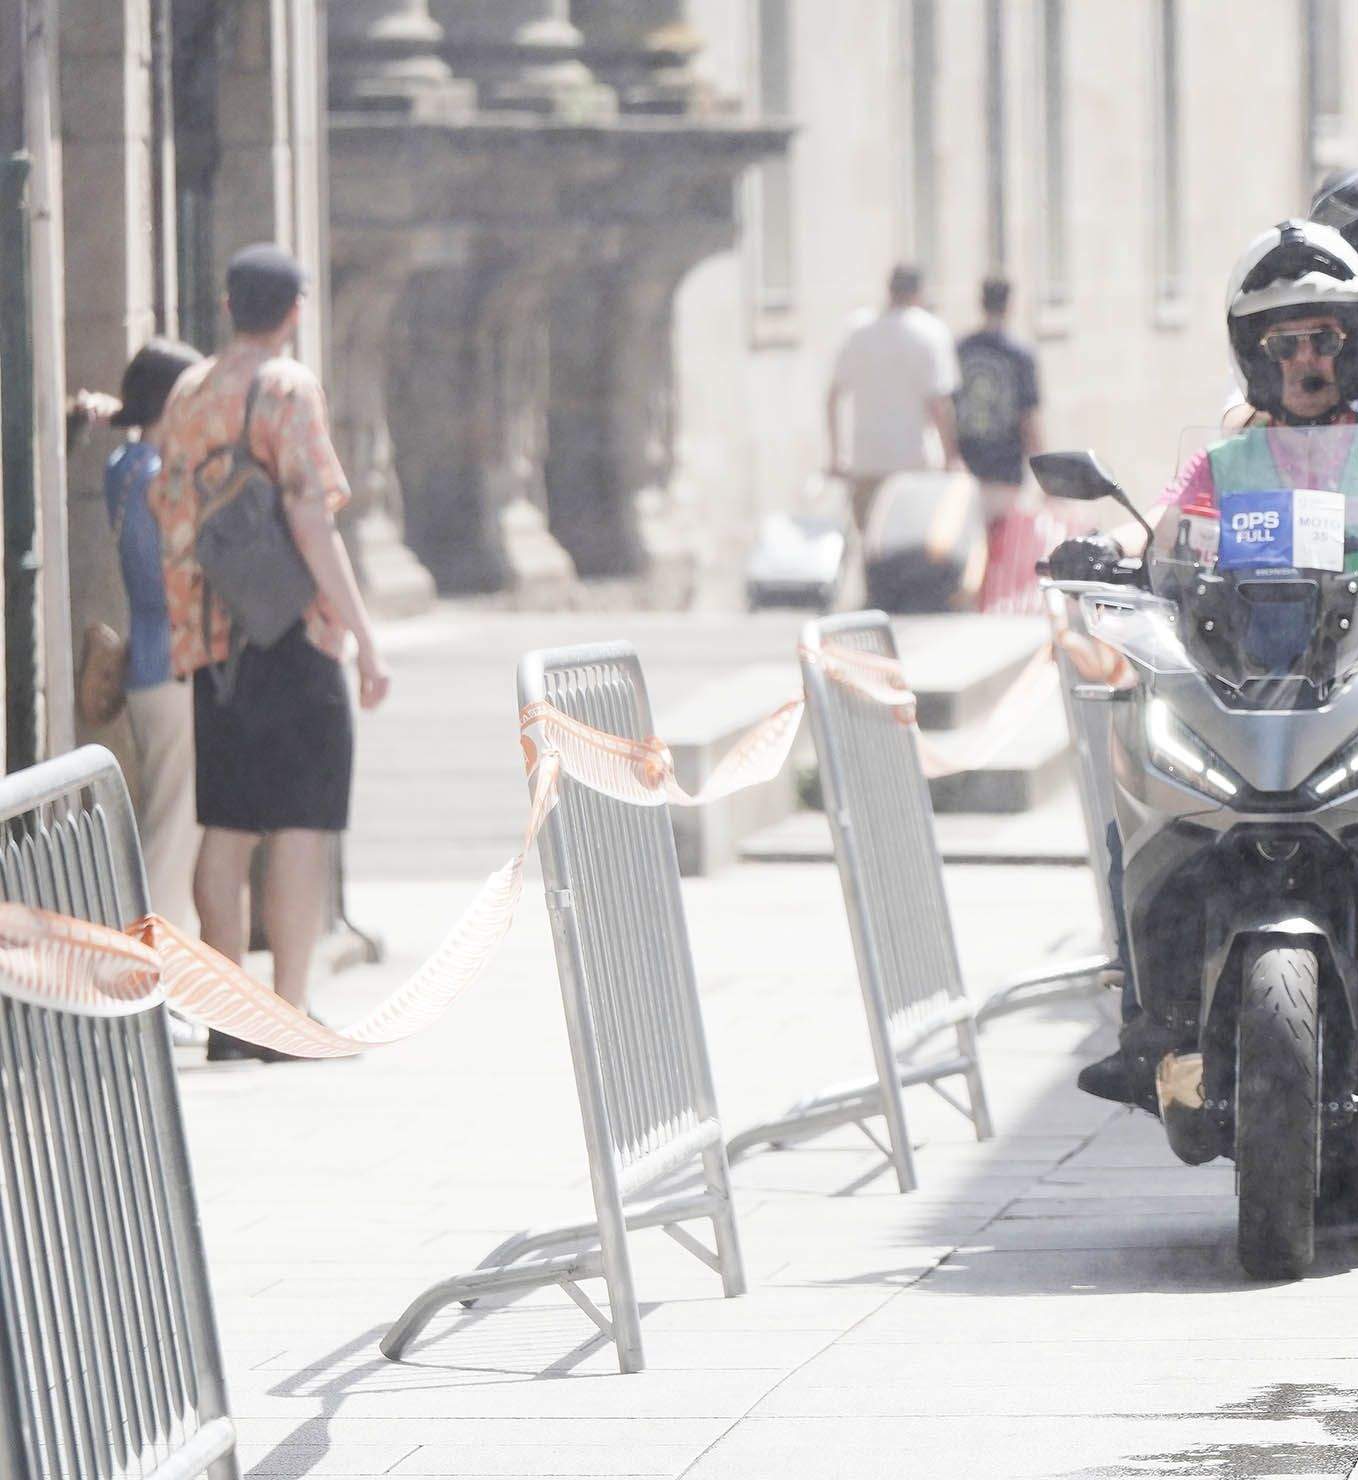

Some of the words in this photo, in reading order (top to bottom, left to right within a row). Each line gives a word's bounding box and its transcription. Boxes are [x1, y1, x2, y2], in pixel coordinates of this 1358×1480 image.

[1231, 511, 1280, 530] OPS
[1236, 529, 1275, 543] FULL
[1256, 568, 1299, 576] HONDA
